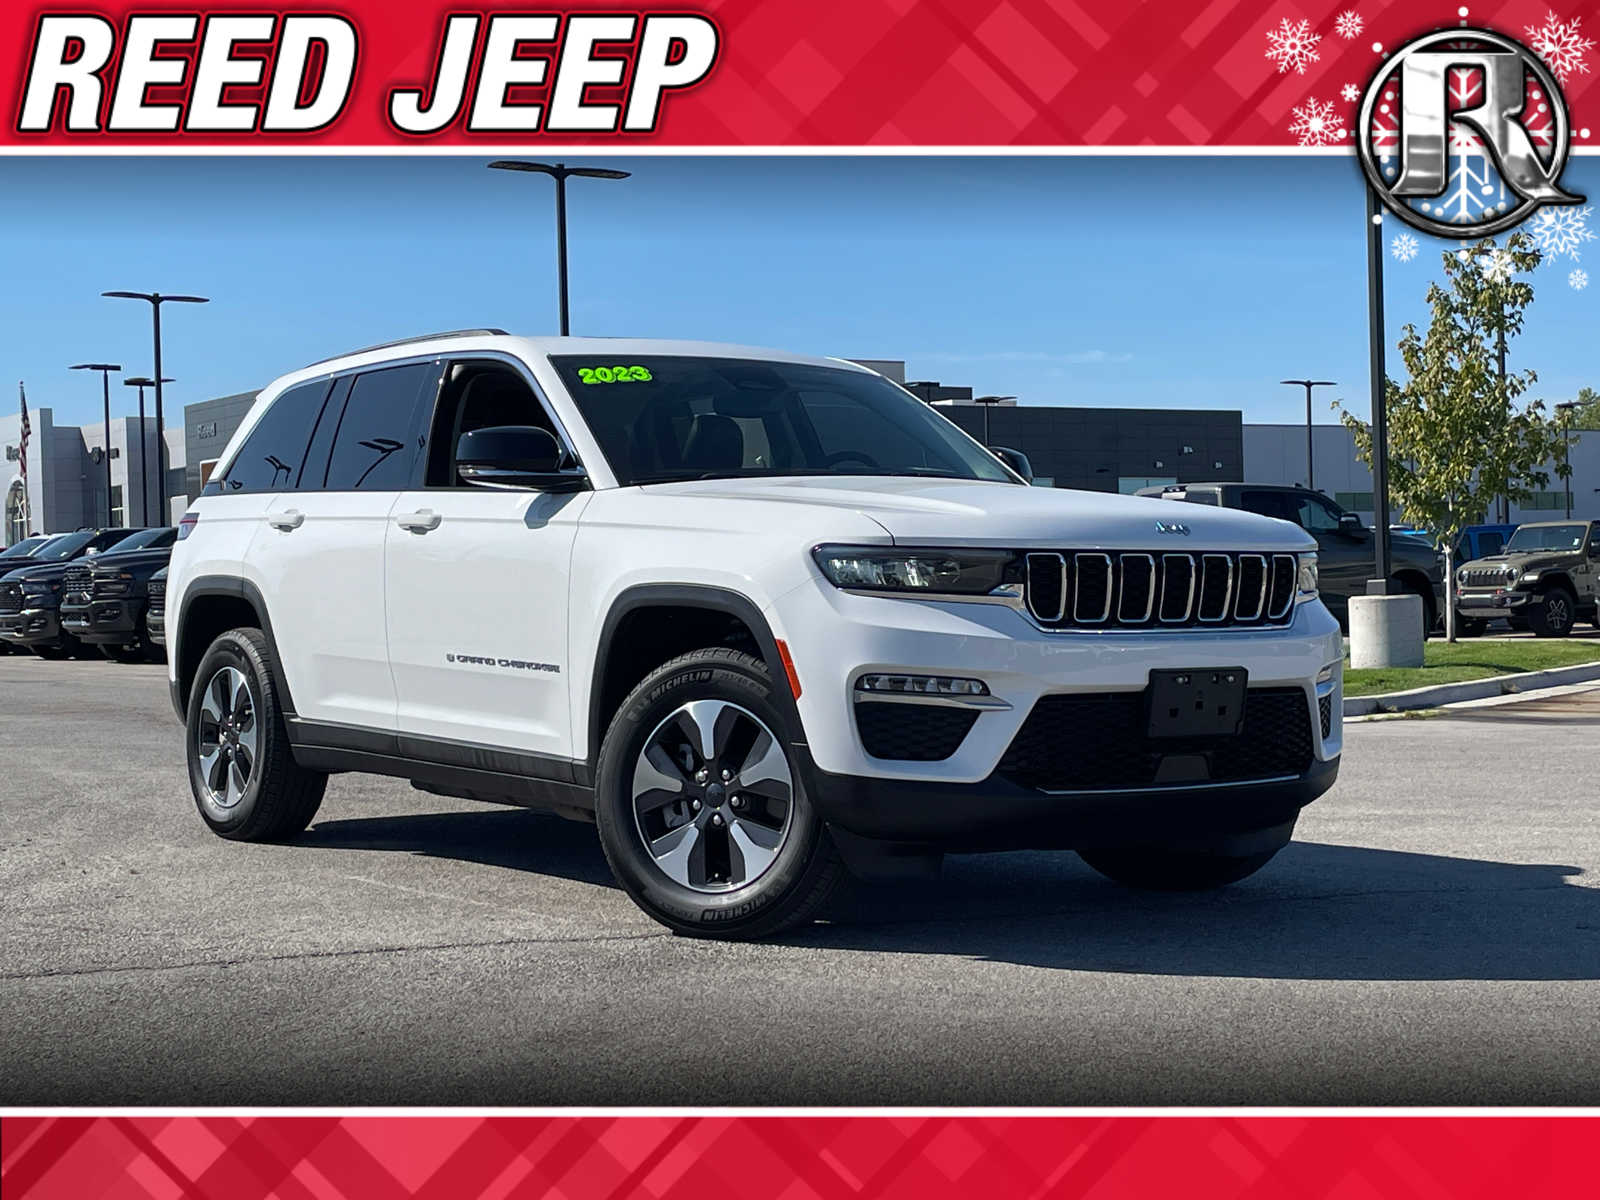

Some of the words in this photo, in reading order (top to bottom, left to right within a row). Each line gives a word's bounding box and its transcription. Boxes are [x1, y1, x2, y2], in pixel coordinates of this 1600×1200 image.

[577, 366, 653, 384] 2023
[456, 654, 496, 666] GRAND
[498, 659, 560, 673] CHEROKEE
[650, 670, 711, 699] MICHELIN
[703, 894, 767, 921] MICHELIN
